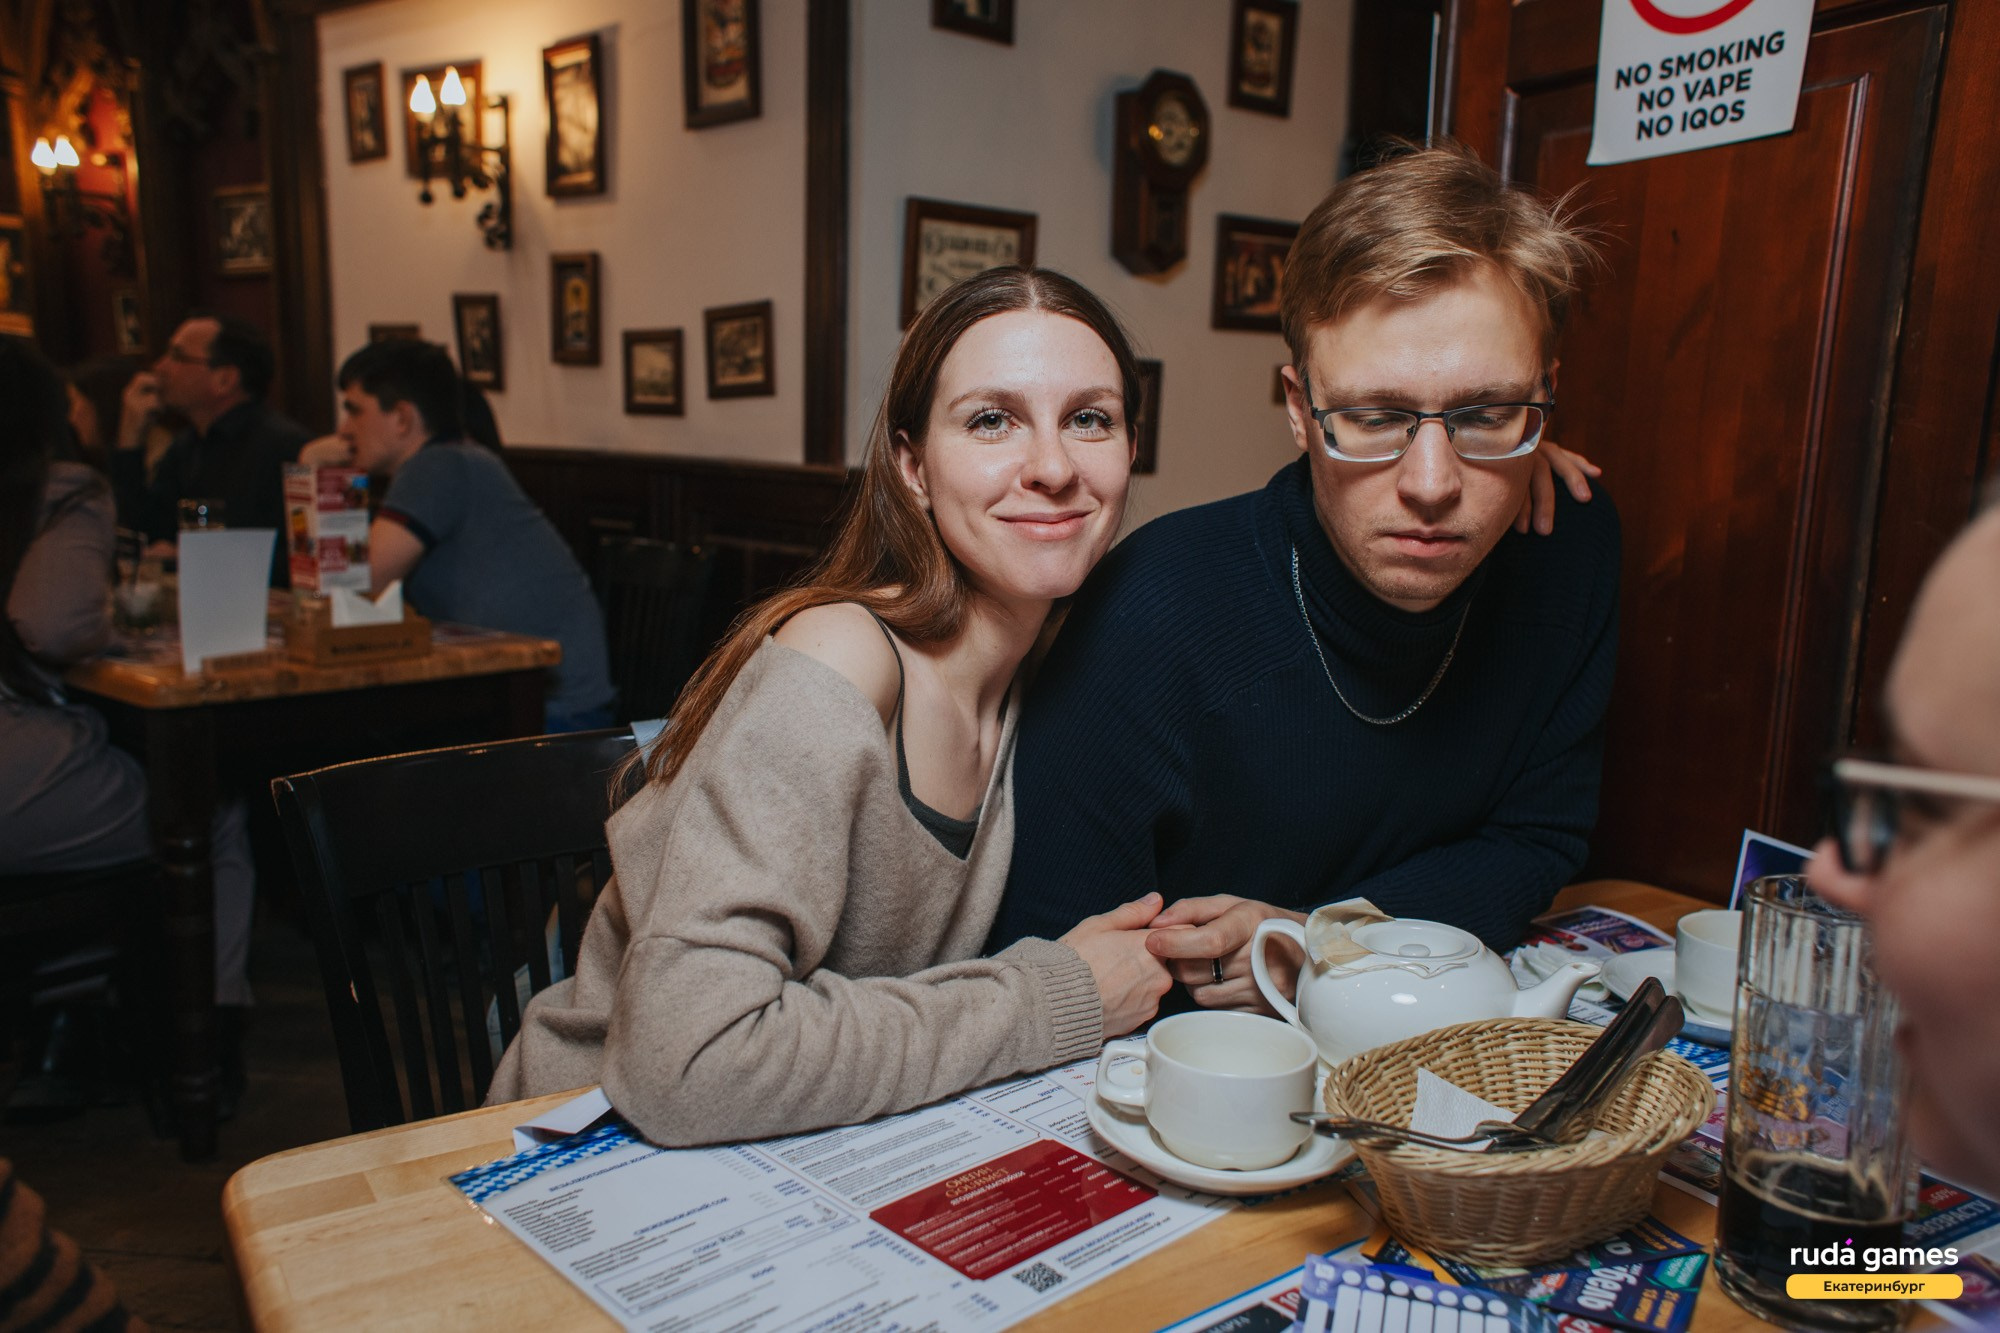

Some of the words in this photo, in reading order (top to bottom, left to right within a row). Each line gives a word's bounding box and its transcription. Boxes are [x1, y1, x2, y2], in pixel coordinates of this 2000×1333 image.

[1615, 63, 1652, 90] NO
[1659, 31, 1785, 79] SMOKING
[1637, 86, 1674, 113] NO
[1684, 68, 1753, 103] VAPE
[1636, 114, 1673, 141] NO
[1681, 100, 1745, 132] IQOS
